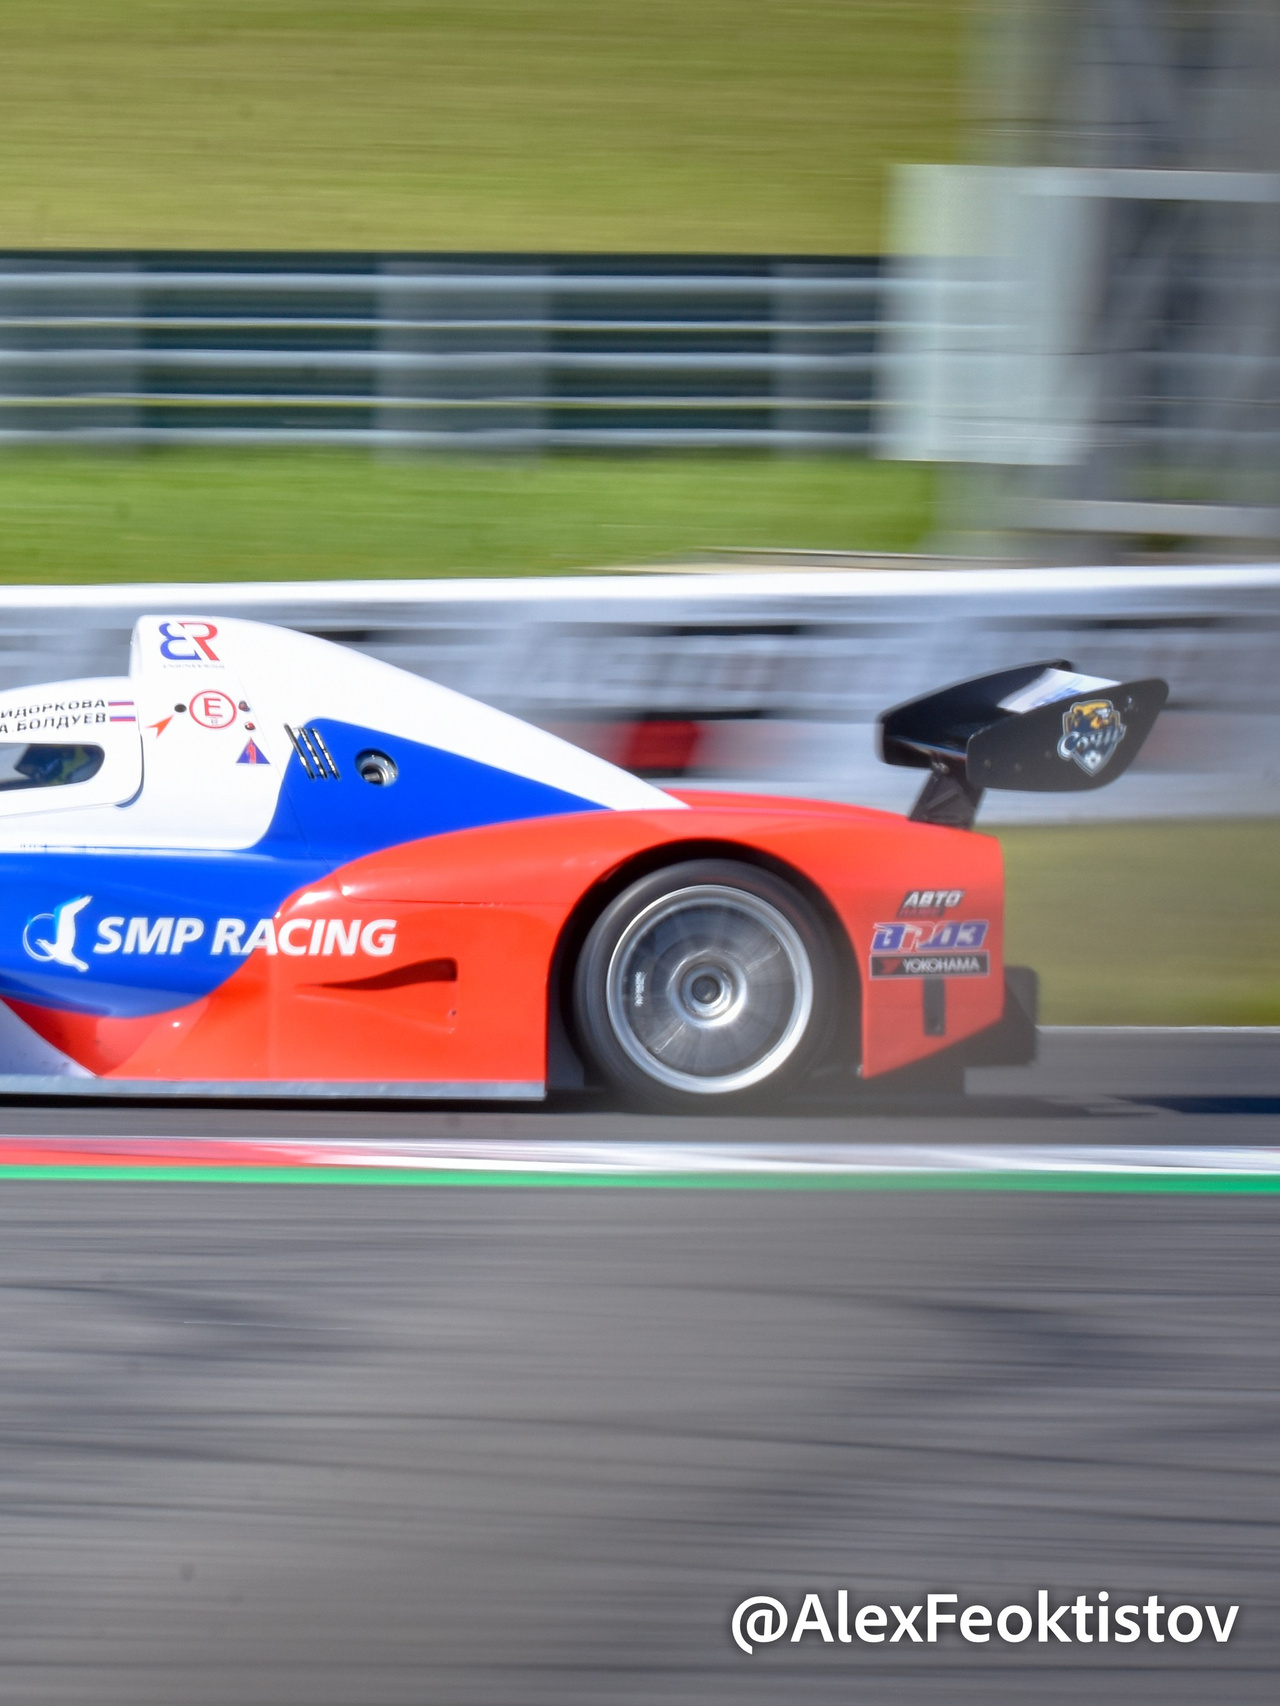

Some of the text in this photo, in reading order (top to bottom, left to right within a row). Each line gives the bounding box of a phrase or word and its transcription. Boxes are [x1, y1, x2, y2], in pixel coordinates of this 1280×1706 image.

[203, 697, 223, 718] E
[902, 890, 963, 908] АВТО
[92, 916, 398, 956] SMP RACING
[903, 956, 981, 974] YOKOHAMA
